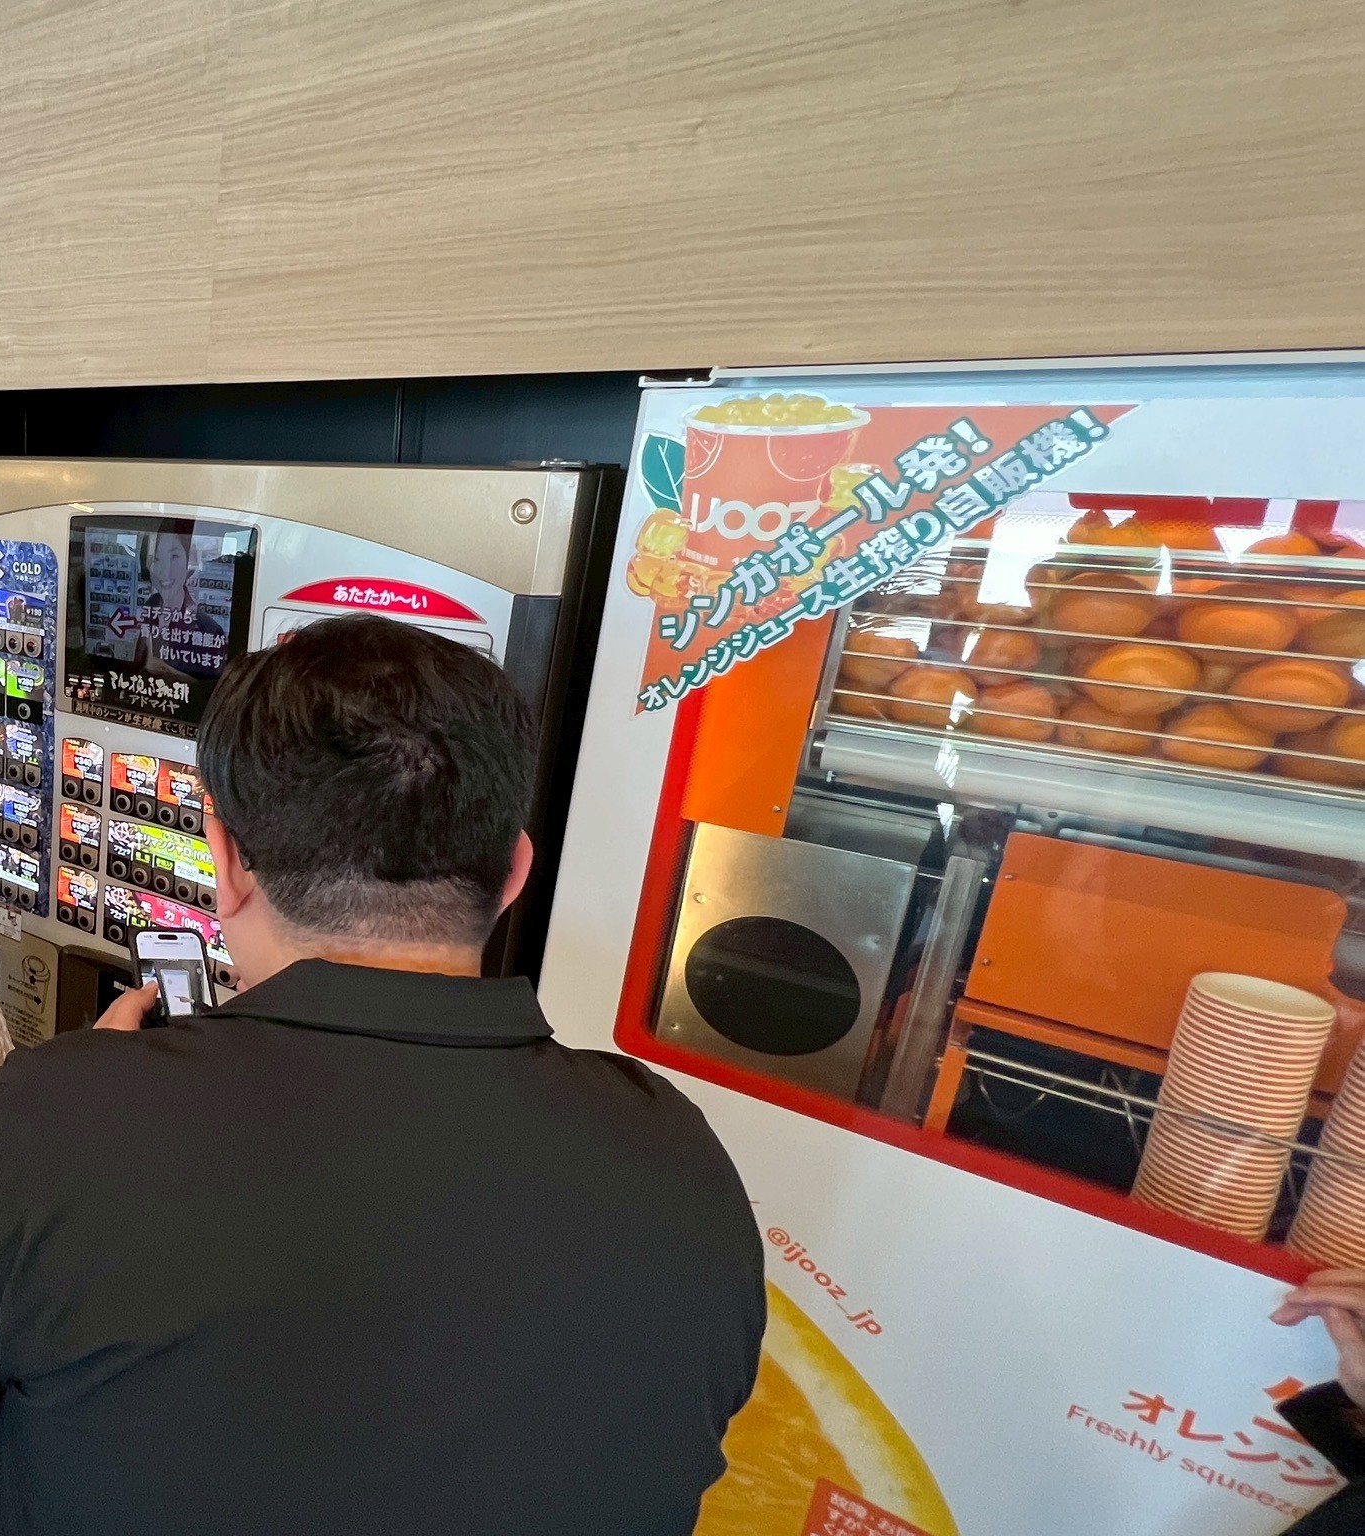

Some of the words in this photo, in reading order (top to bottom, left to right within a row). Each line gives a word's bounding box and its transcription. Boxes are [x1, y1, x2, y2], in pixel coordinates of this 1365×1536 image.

[662, 418, 990, 650] シンガポール発!
[13, 562, 41, 575] COLD
[639, 406, 1112, 710] オレンジジュース生搾り自販機!
[333, 584, 427, 609] あたたか〜い
[141, 605, 193, 624] コチラから
[159, 646, 224, 669] 付いています
[129, 694, 180, 715] アドマイヤ
[767, 1227, 883, 1335] @ijooz_jp
[1066, 1403, 1173, 1463] Freshly
